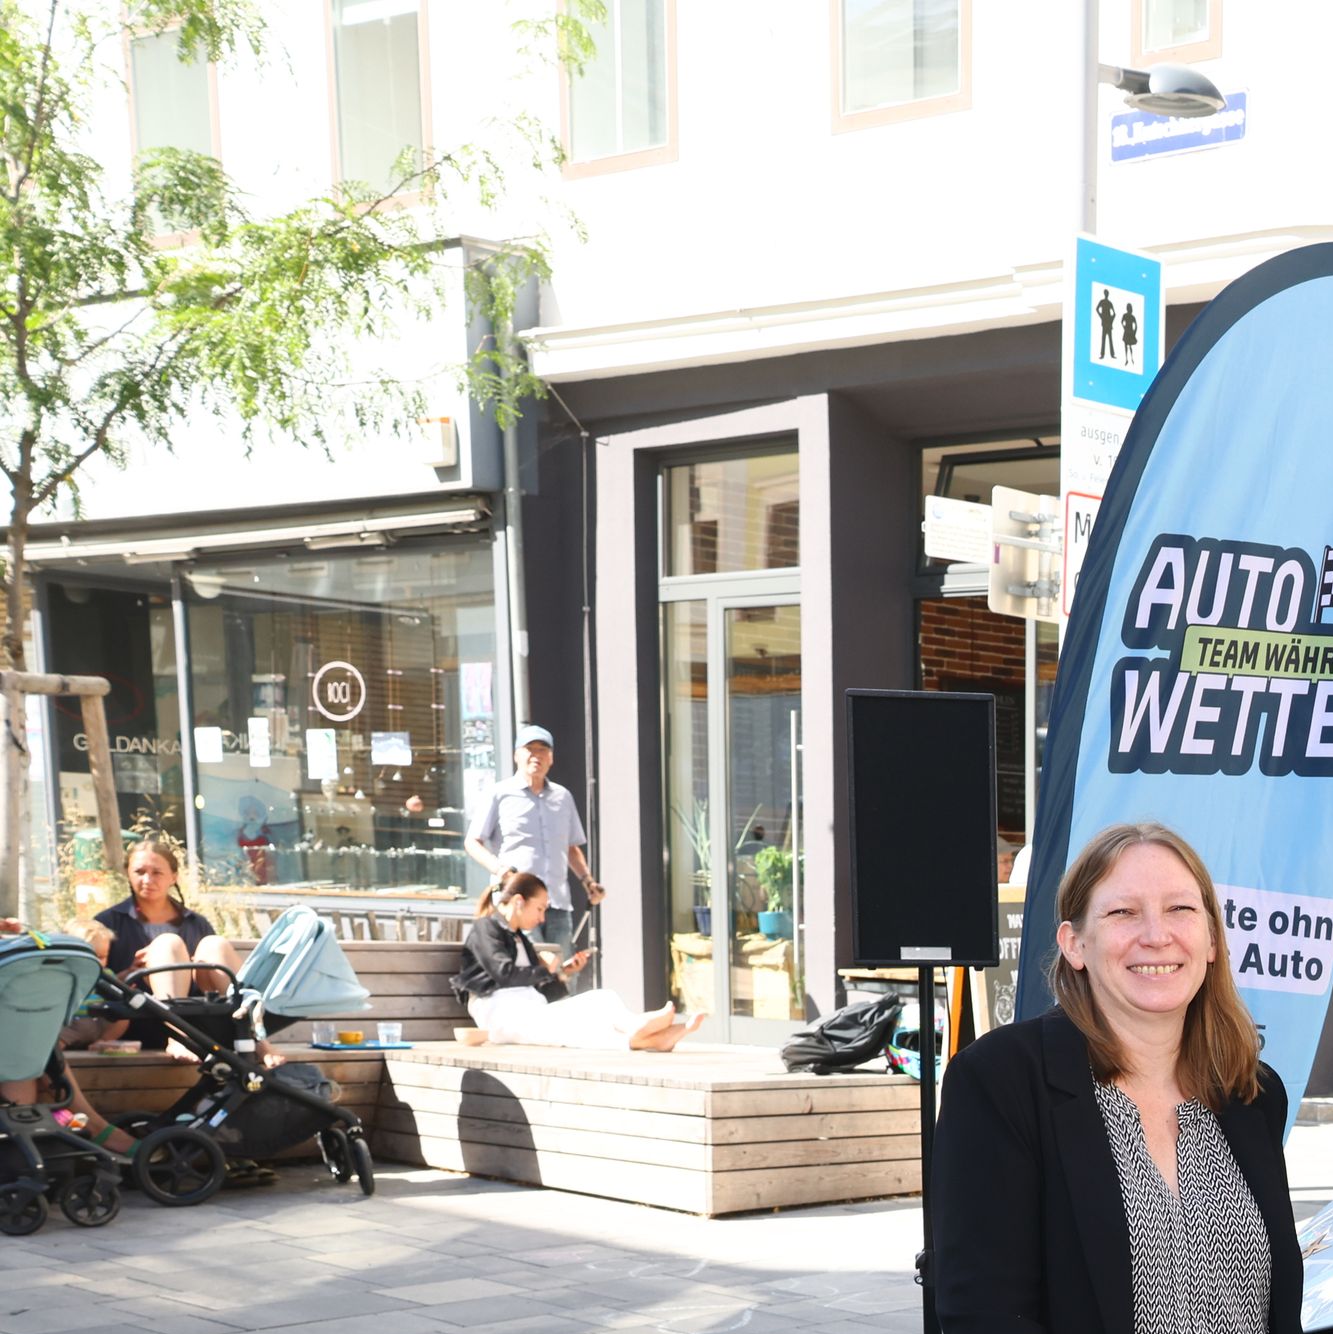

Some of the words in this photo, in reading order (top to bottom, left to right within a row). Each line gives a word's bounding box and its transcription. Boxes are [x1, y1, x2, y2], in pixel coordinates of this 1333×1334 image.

[1135, 546, 1304, 632] AUTO
[1198, 637, 1260, 670] TEAM
[1239, 943, 1323, 981] Auto
